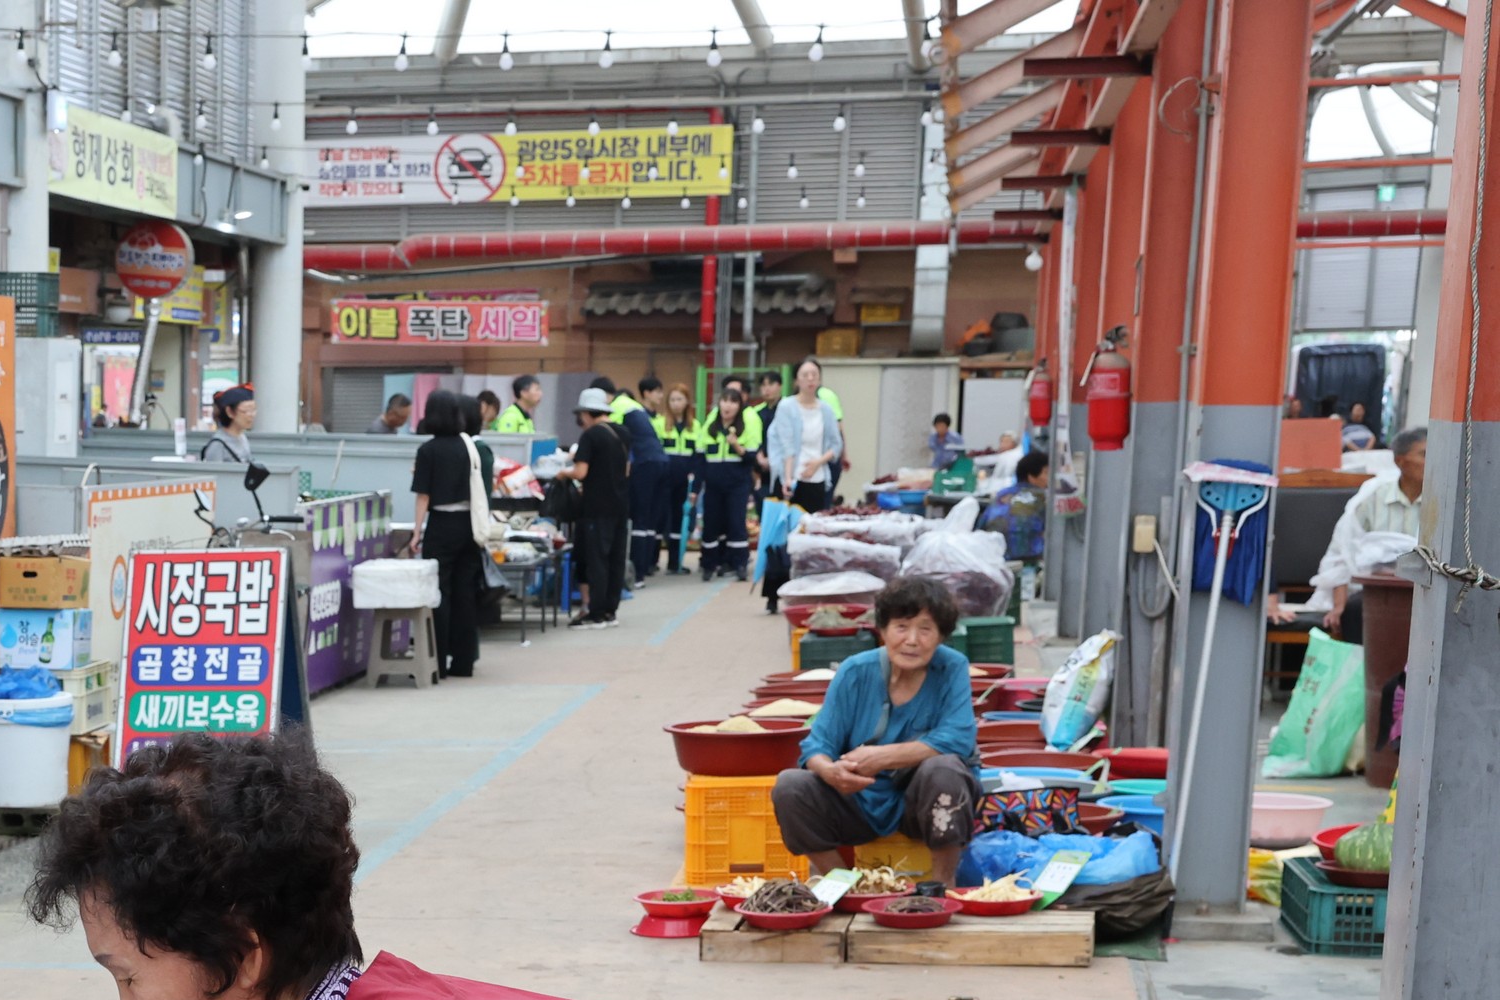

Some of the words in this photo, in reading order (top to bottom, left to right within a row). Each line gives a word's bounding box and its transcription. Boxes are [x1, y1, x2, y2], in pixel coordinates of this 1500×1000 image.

[71, 125, 134, 190] 형제상회
[517, 136, 641, 162] 광양5일시장
[647, 133, 712, 157] 내부에
[405, 163, 431, 178] 하차
[517, 162, 579, 187] 주차를
[588, 159, 703, 185] 금지합니다.
[339, 306, 398, 339] 이불
[407, 306, 472, 341] 폭탄
[477, 306, 541, 341] 세일
[134, 558, 275, 637] 시장국밥
[137, 645, 263, 682] 곱창전골
[134, 693, 260, 729] 새끼보수육
